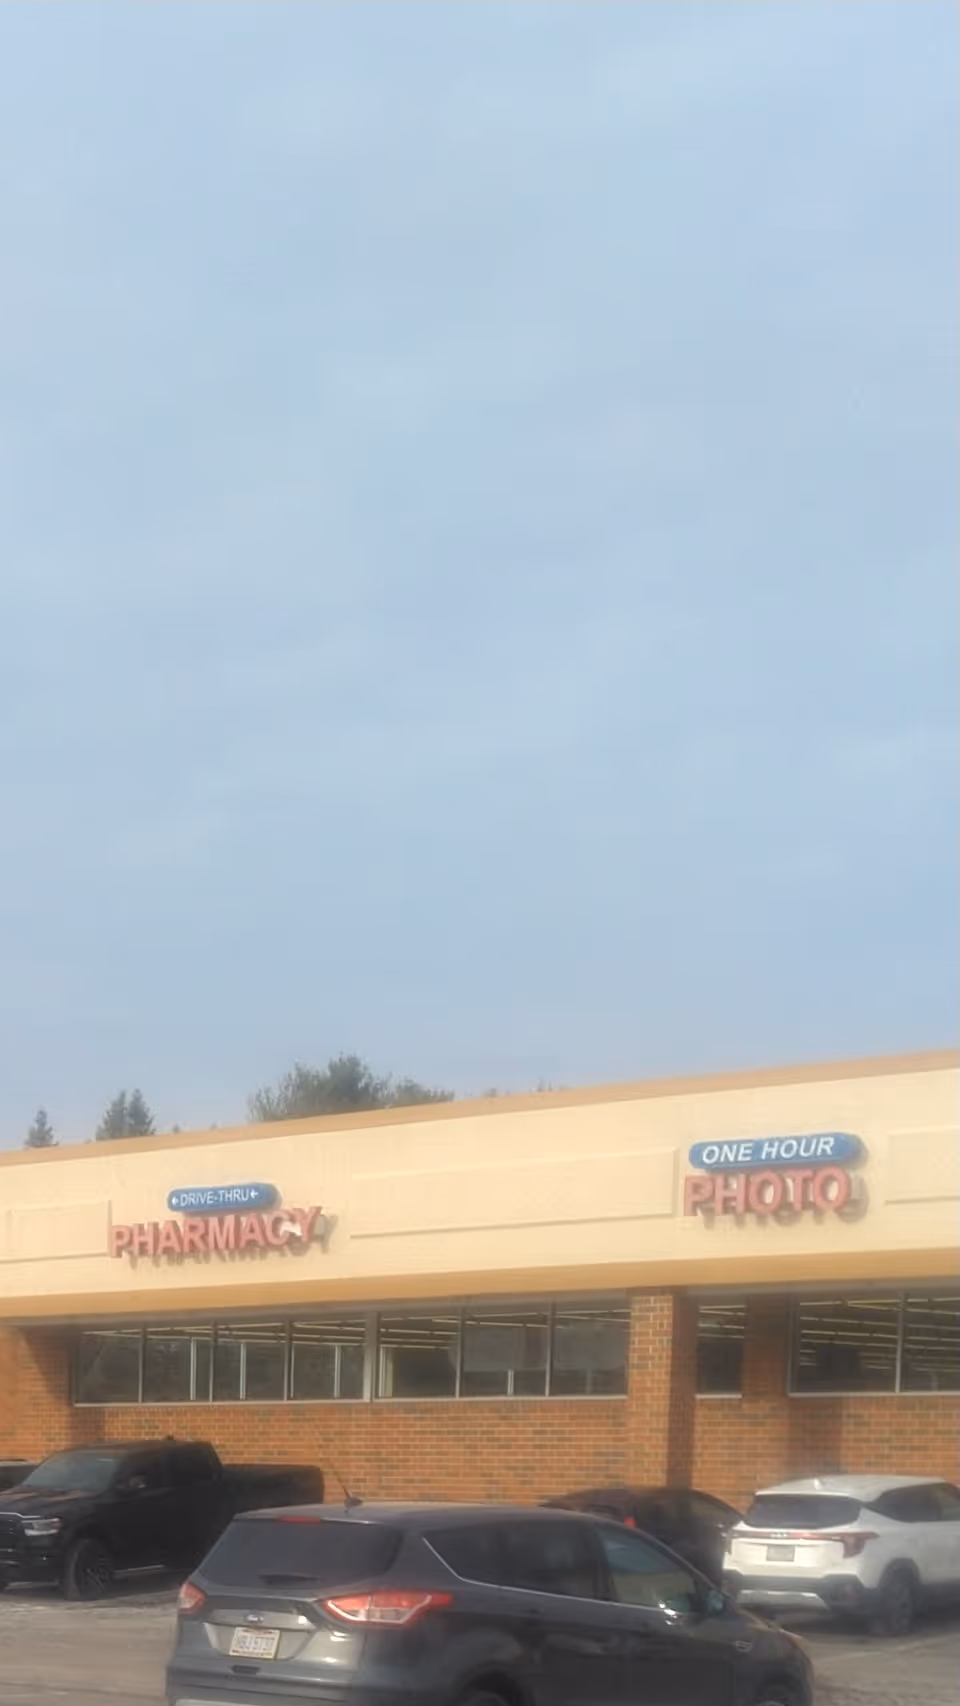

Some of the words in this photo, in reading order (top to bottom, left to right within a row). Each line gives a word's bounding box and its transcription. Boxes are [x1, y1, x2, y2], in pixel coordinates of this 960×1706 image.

[702, 1143, 753, 1165] ONE
[761, 1136, 835, 1160] HOUR
[179, 1188, 250, 1207] DRIVE-THRU
[683, 1166, 852, 1217] PHOTO
[109, 1206, 323, 1258] PHARMACY
